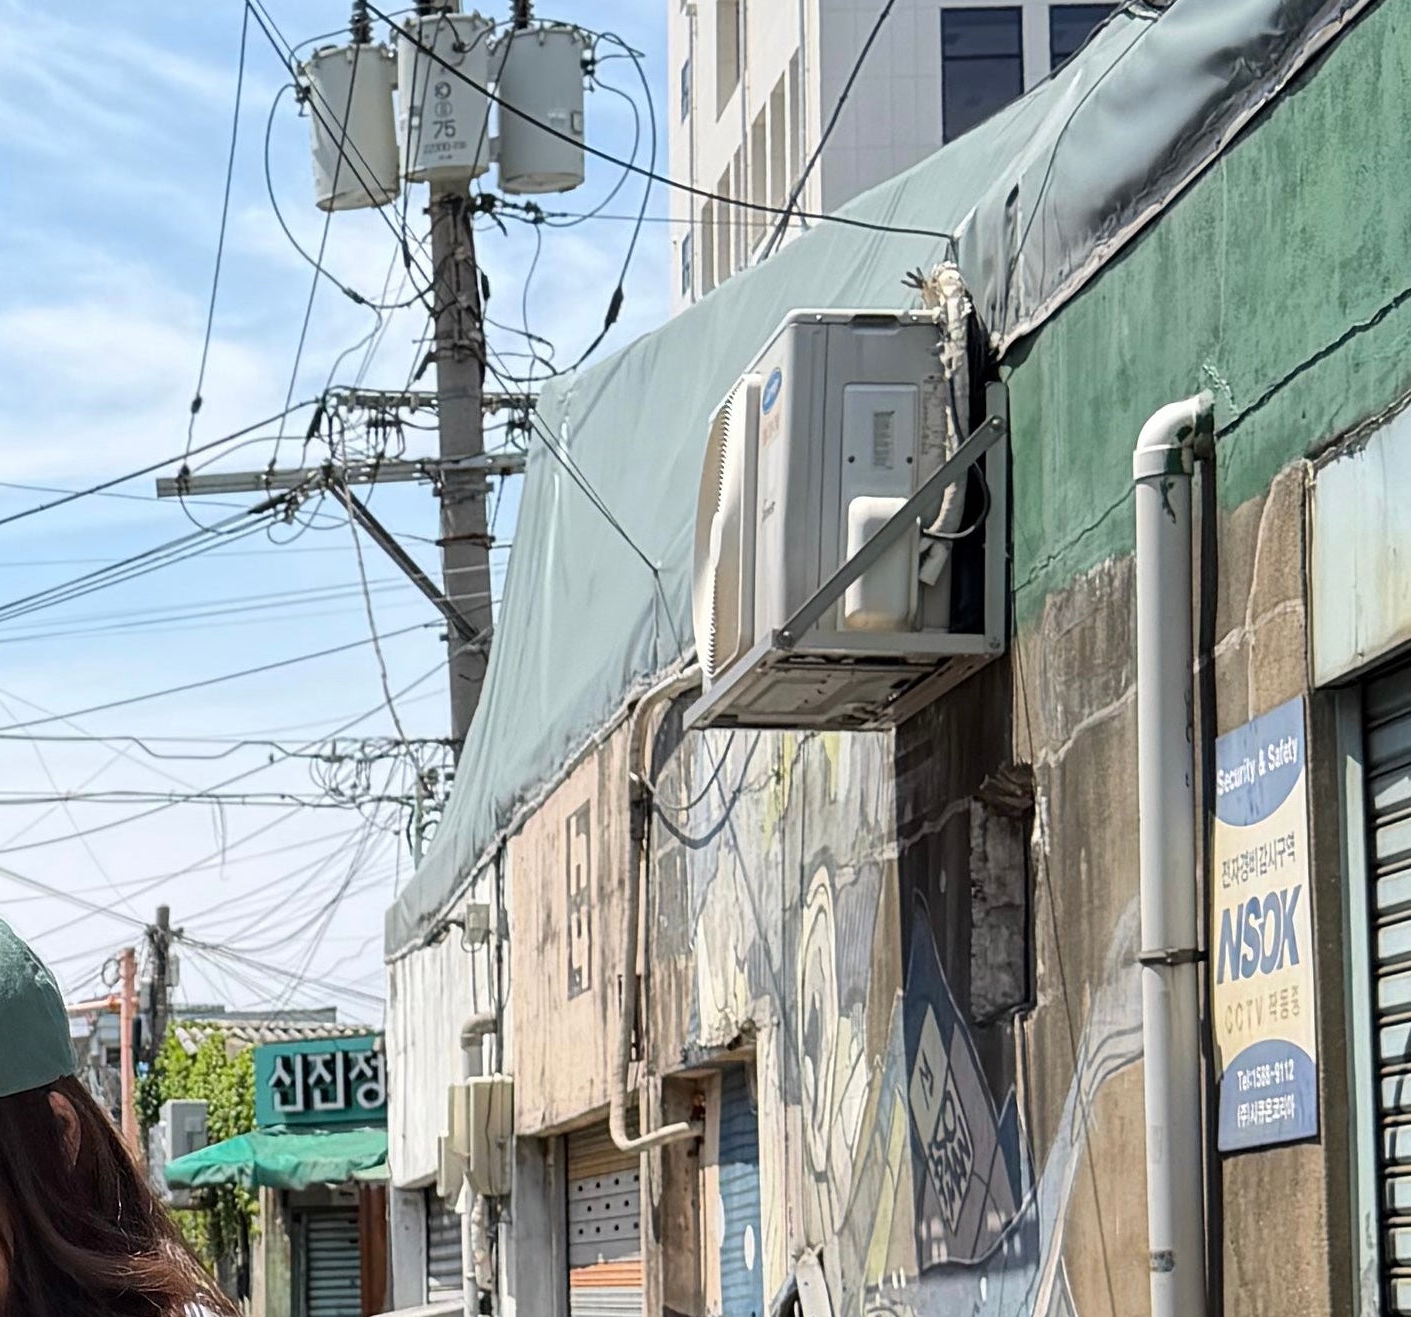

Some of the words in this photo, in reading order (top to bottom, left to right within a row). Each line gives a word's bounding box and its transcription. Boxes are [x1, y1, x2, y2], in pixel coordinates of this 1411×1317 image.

[432, 119, 456, 139] 75
[1216, 757, 1256, 796] Security
[1258, 748, 1266, 777] &
[1268, 736, 1298, 771] Safety
[1222, 831, 1296, 888] 전자경비감시구역
[1216, 884, 1302, 985] NSOK
[1225, 996, 1263, 1034] CCTV
[268, 1050, 386, 1112] 신진정
